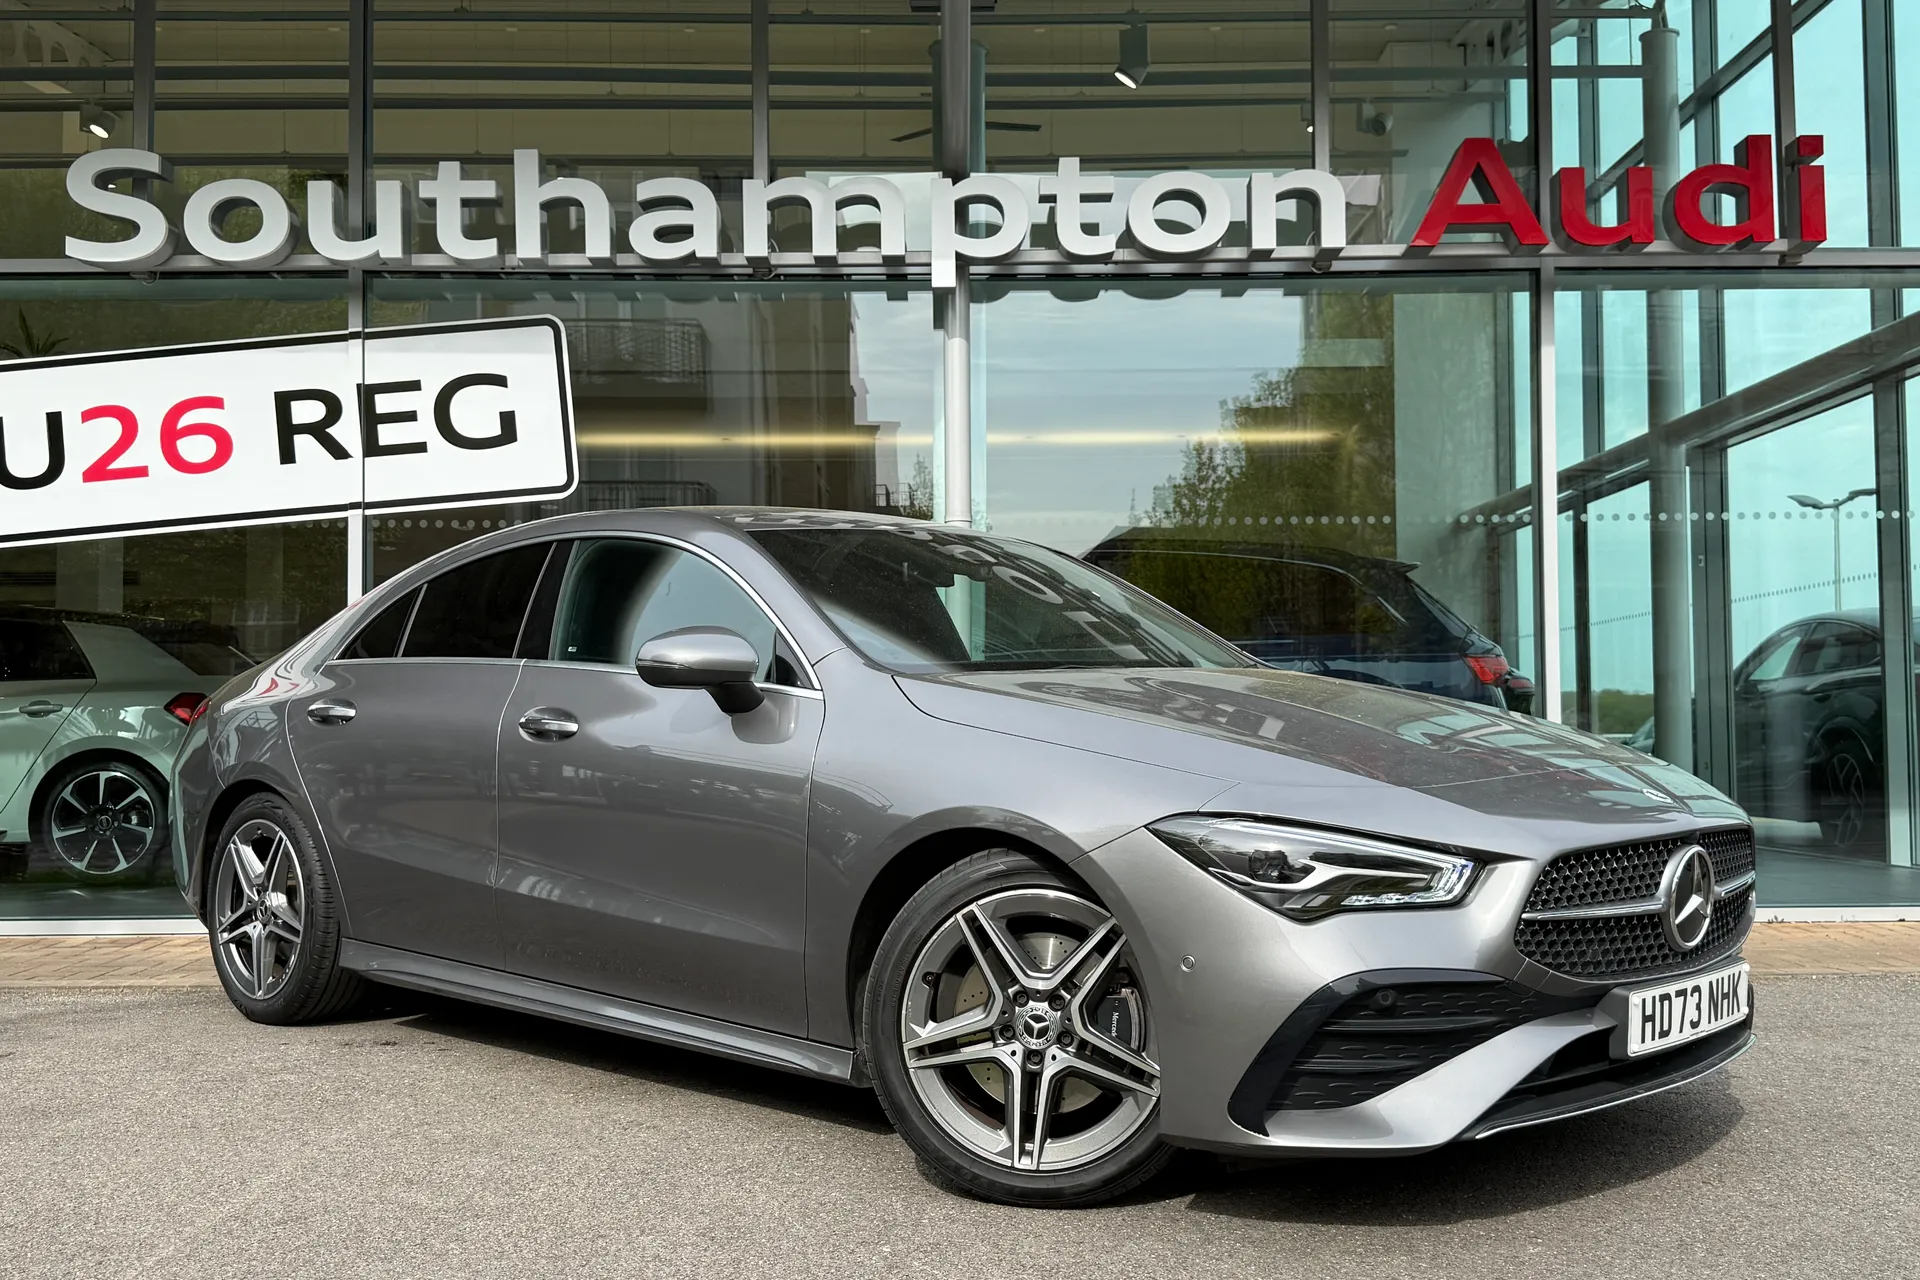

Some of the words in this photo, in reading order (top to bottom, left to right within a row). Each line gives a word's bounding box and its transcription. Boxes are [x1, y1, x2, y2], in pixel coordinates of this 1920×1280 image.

[64, 147, 1348, 289] Southampton
[1409, 134, 1828, 252] Audi
[272, 373, 518, 466] REG
[1641, 984, 1702, 1044] HD73
[1707, 970, 1742, 1025] NHK
